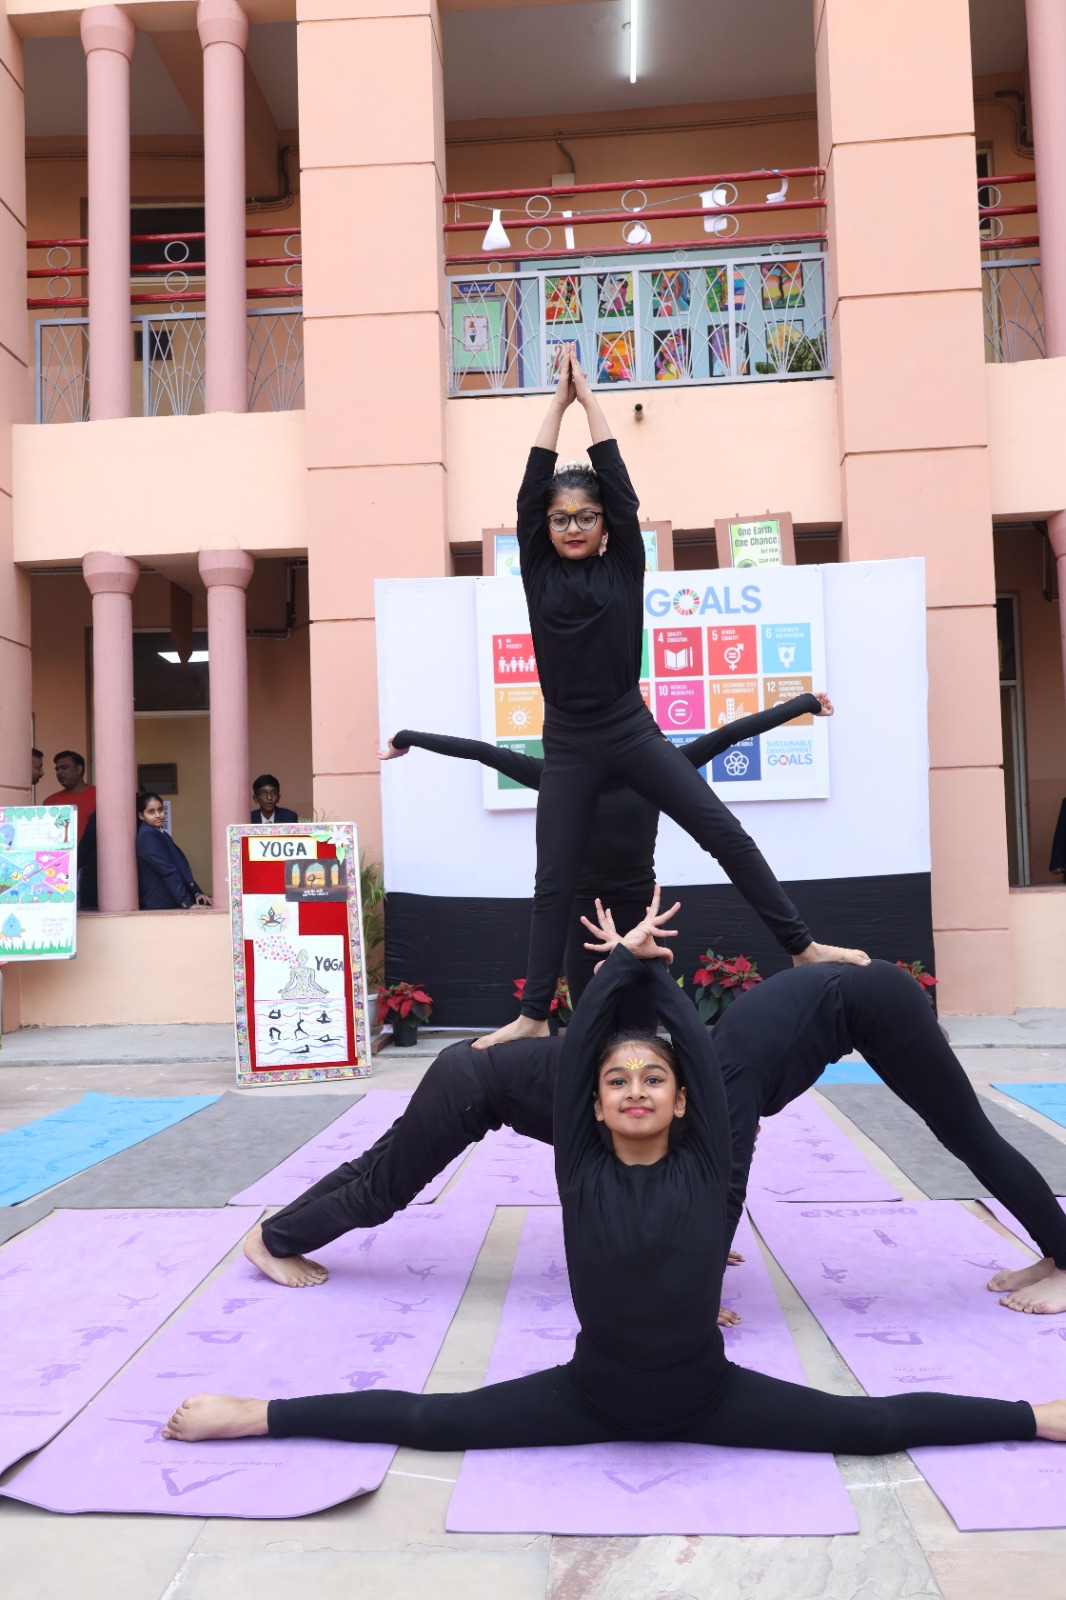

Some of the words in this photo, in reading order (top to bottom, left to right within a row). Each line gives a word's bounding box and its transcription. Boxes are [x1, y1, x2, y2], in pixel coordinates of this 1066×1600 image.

[738, 528, 751, 536] One
[753, 526, 772, 535] Earth
[734, 539, 748, 547] One
[750, 537, 777, 546] Chance
[645, 585, 762, 617] GOALS
[657, 632, 664, 643] 4
[712, 629, 718, 641] 5
[765, 628, 772, 639] 6
[497, 638, 502, 650] 1
[658, 685, 668, 696] 10
[712, 683, 720, 694] 11
[766, 681, 776, 692] 12
[499, 691, 504, 702] 7
[767, 753, 813, 766] GOALS
[259, 841, 307, 857] YOGA
[315, 955, 344, 971] YOGA
